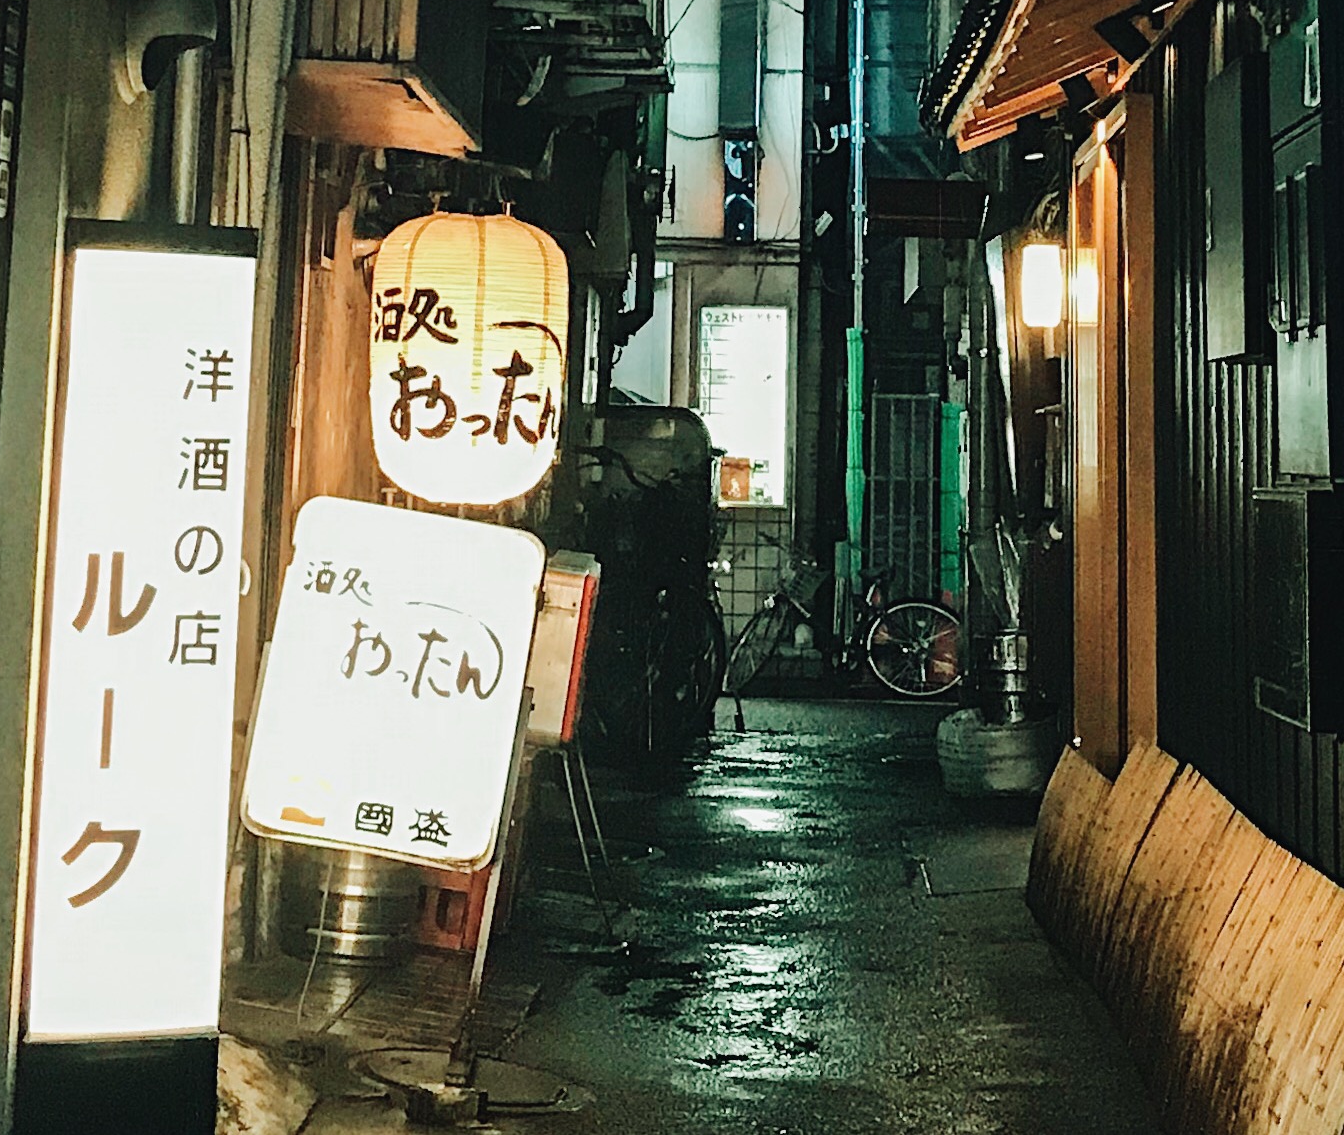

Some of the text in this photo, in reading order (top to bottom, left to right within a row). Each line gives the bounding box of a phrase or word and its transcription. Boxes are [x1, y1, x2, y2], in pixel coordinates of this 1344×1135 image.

[374, 287, 459, 345] 酒処
[169, 347, 235, 669] 洋酒の店
[303, 561, 374, 607] 酒処
[60, 550, 158, 909] ルーク
